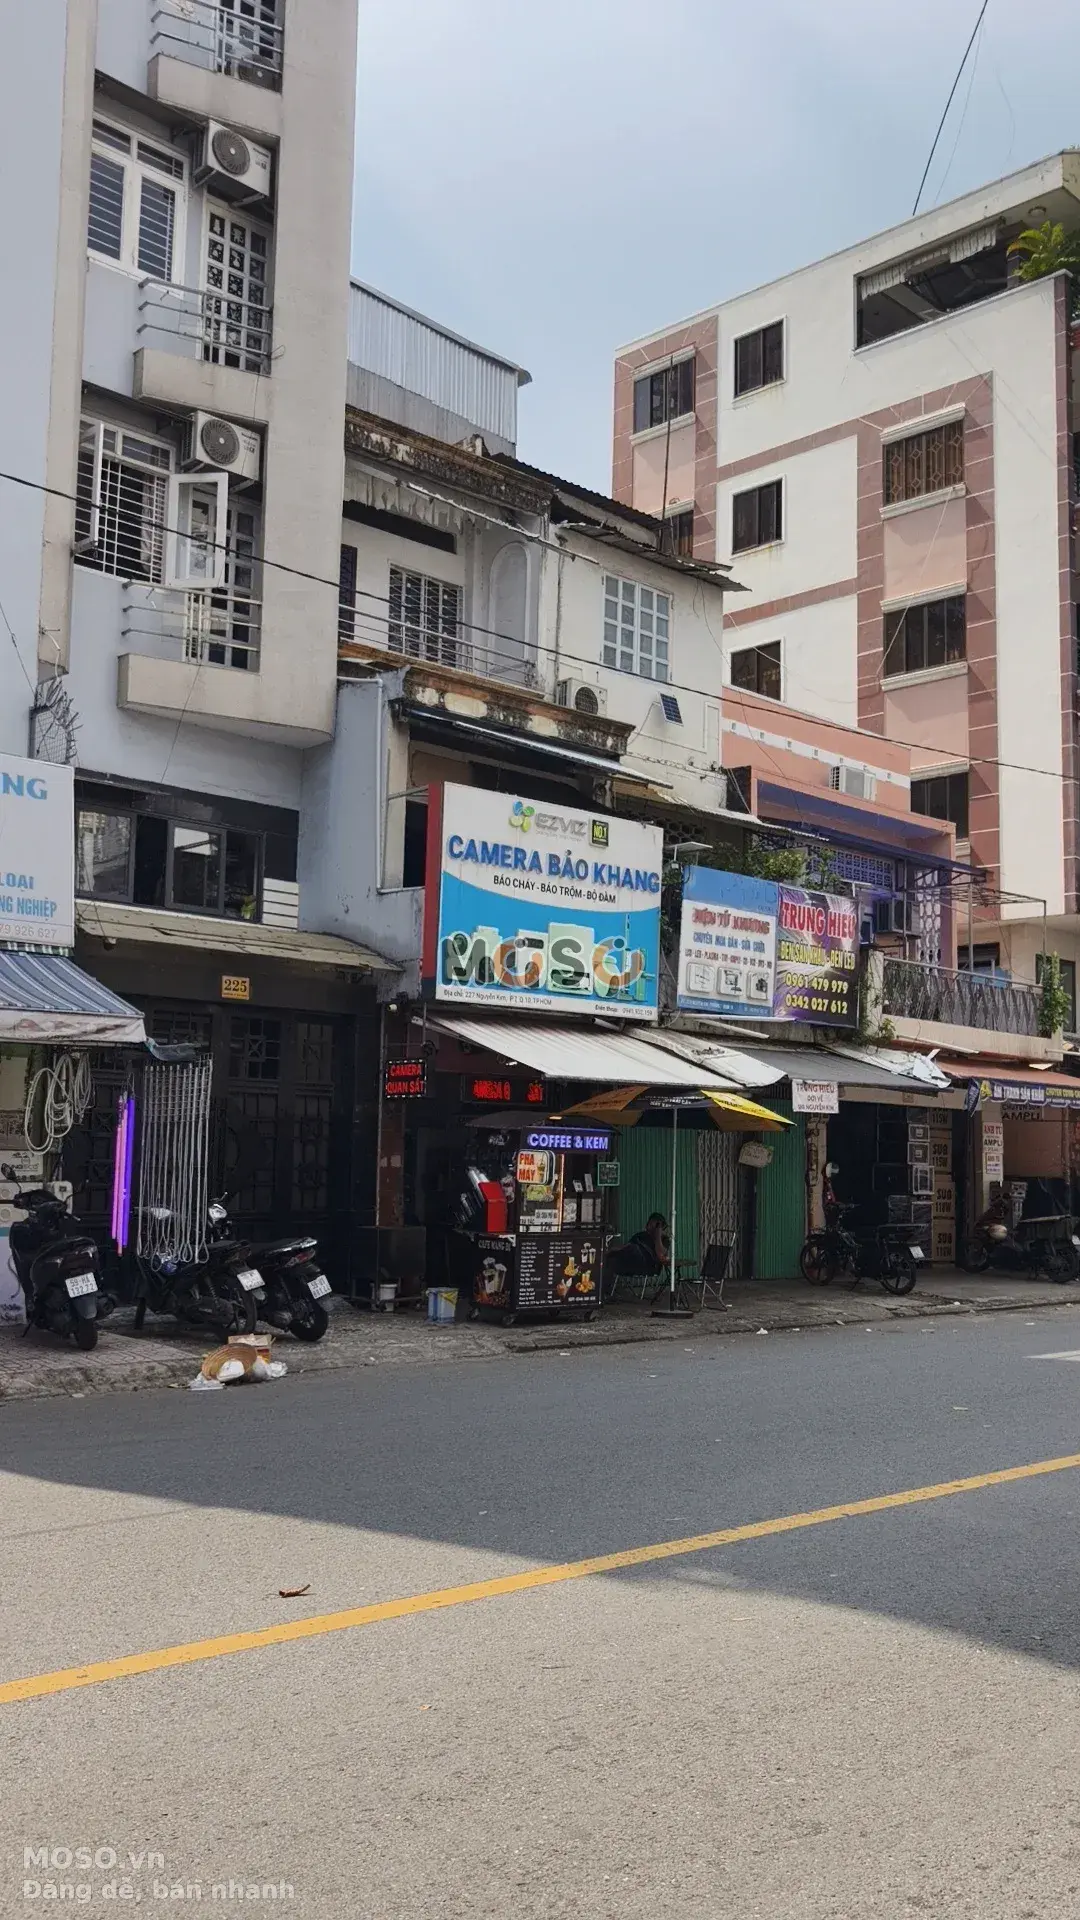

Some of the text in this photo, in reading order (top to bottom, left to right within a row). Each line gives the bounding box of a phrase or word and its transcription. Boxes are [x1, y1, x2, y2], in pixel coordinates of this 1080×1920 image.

[448, 835, 661, 894] CAMERA BẢO KHANG
[493, 874, 511, 887] BÁO
[512, 878, 535, 891] CHÁY
[540, 882, 558, 895] BÁO
[559, 885, 583, 899] TRỘM
[586, 890, 598, 903] BỘ
[782, 901, 826, 936] TRUNG
[224, 978, 247, 993] 225
[785, 971, 849, 995] 0961 479 979
[785, 993, 848, 1015] 0342 027 612
[390, 1064, 422, 1077] CAMERA
[527, 1133, 572, 1148] COFFEE
[575, 1134, 583, 1149] &
[585, 1135, 610, 1150] KEM
[519, 1153, 535, 1166] PHA
